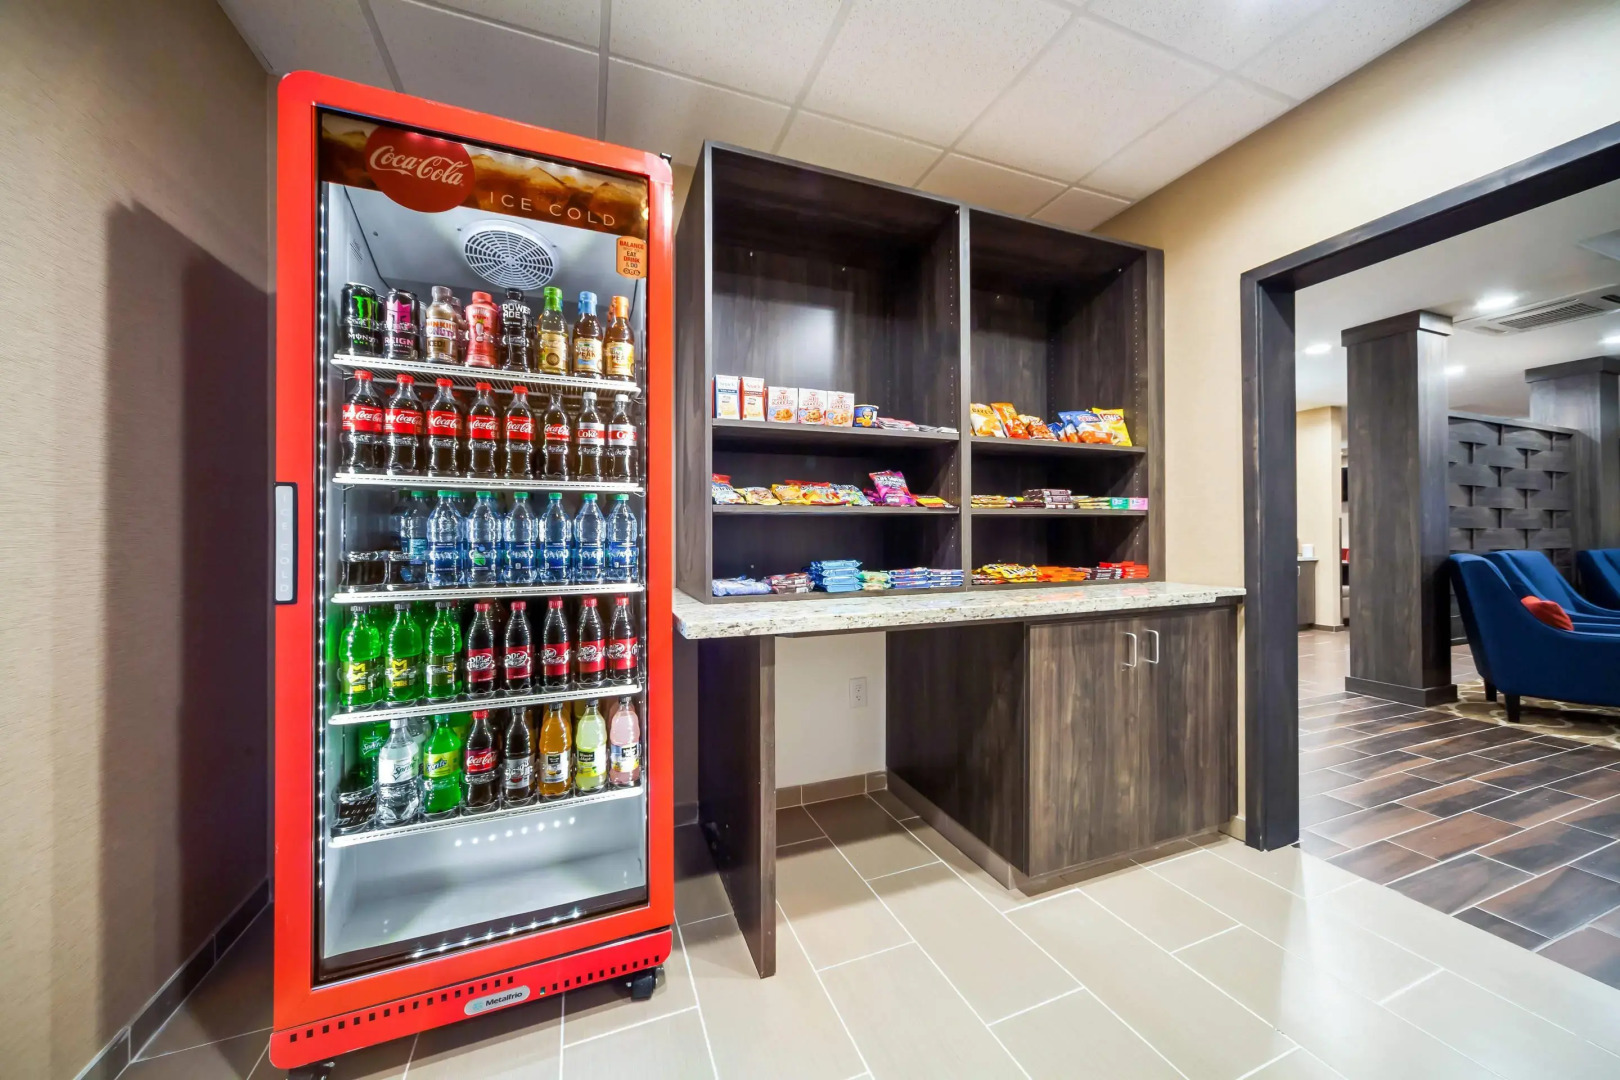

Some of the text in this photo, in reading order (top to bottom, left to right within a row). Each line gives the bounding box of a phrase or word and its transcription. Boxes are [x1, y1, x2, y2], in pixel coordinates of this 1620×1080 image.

[369, 145, 468, 186] Coca-Cola
[489, 191, 615, 227] ICE COLD
[619, 240, 644, 250] BALANCE
[502, 303, 531, 315] POWER
[502, 311, 520, 319] ADE
[577, 429, 598, 438] Coke
[466, 751, 498, 767] Coca-Cola
[485, 991, 523, 1007] Metalfrio
